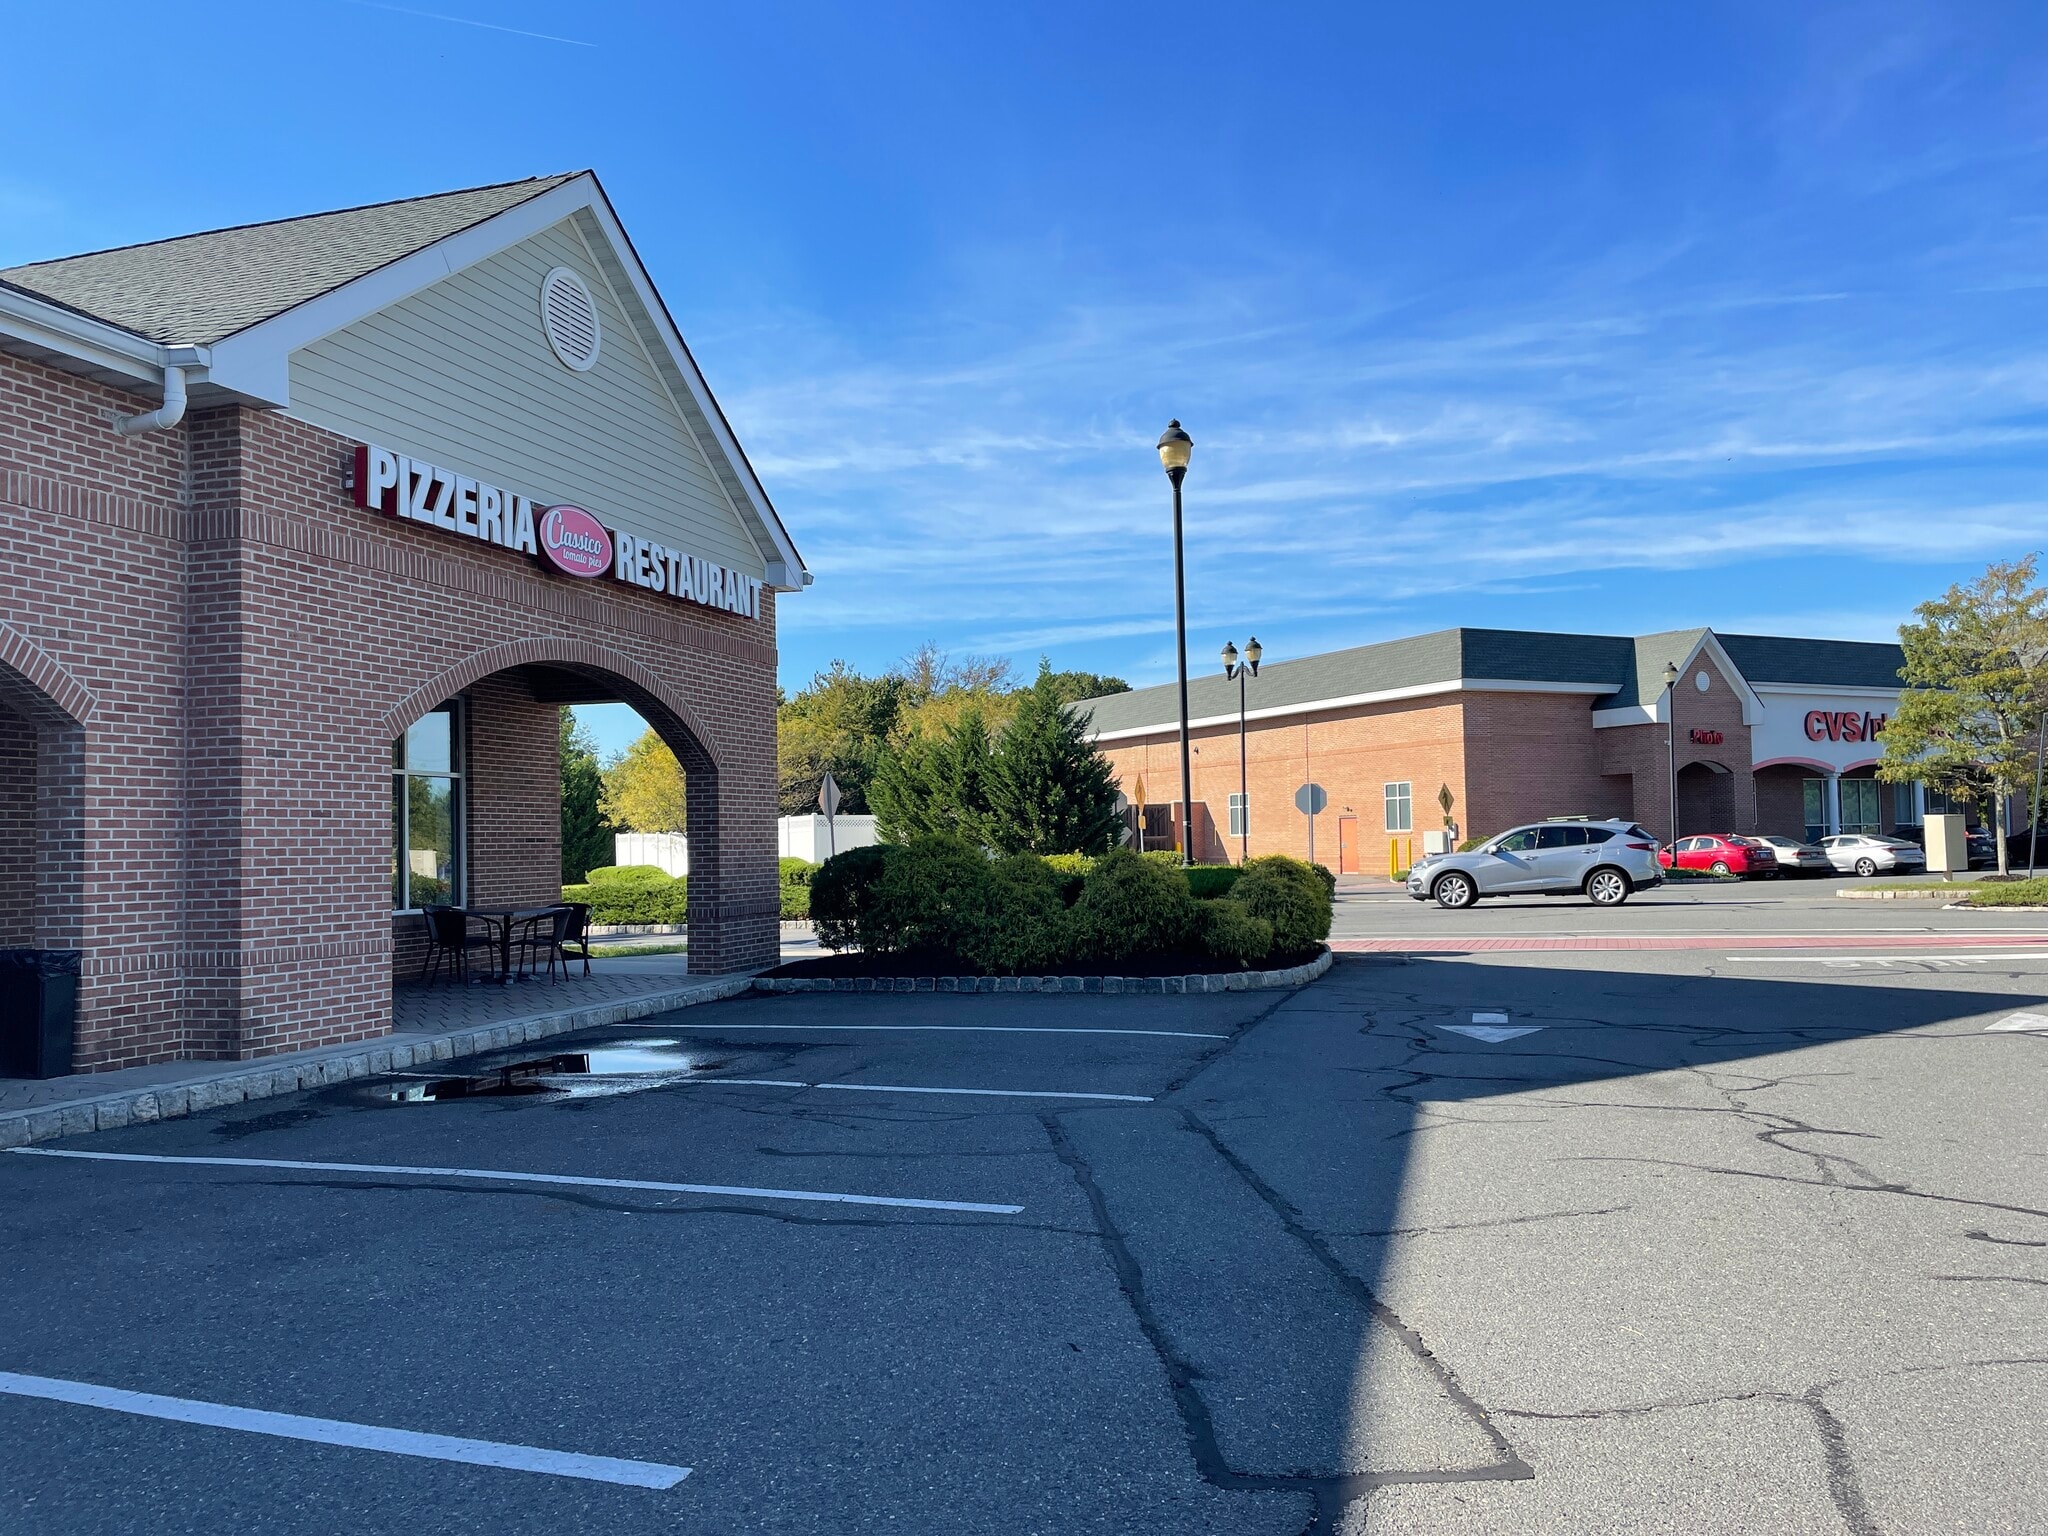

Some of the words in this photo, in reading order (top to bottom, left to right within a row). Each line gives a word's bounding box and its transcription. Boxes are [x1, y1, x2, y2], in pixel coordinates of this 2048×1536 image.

[367, 444, 538, 556] PIZZERIA
[546, 510, 602, 555] Classico
[563, 548, 587, 564] tomato
[588, 556, 602, 569] pies
[615, 530, 763, 621] RESTAURANT
